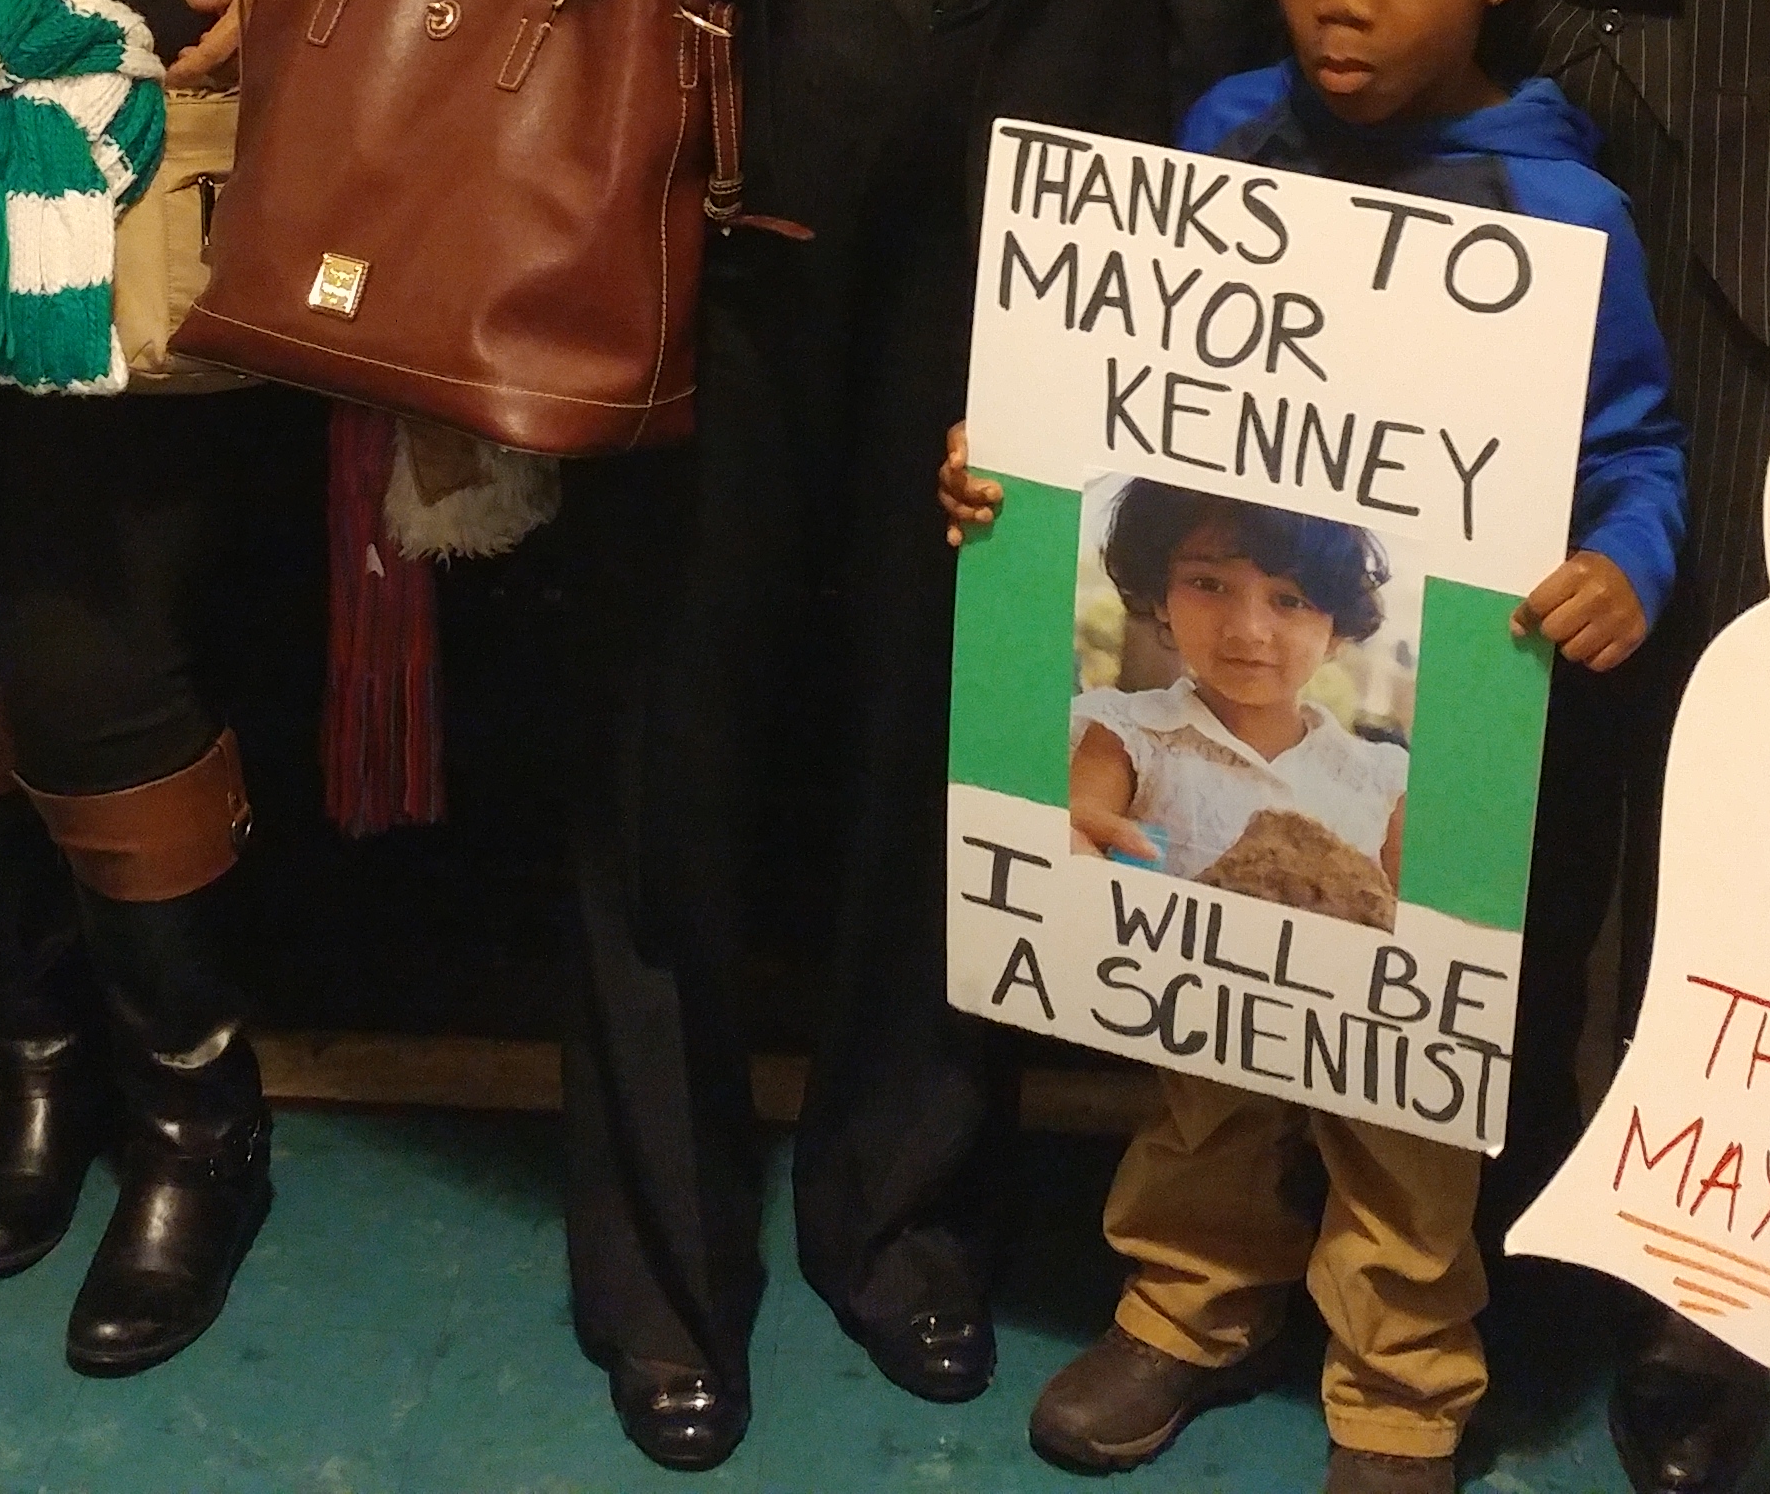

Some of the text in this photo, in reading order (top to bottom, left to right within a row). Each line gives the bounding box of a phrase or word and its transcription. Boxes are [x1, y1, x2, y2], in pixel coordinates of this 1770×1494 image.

[998, 231, 1327, 382] MAYOR
[999, 126, 1532, 314] THANKS TO
[1106, 358, 1500, 540] KENNEY
[961, 836, 1508, 1047] I WILL BE
[991, 937, 1513, 1139] A SCIENTIST
